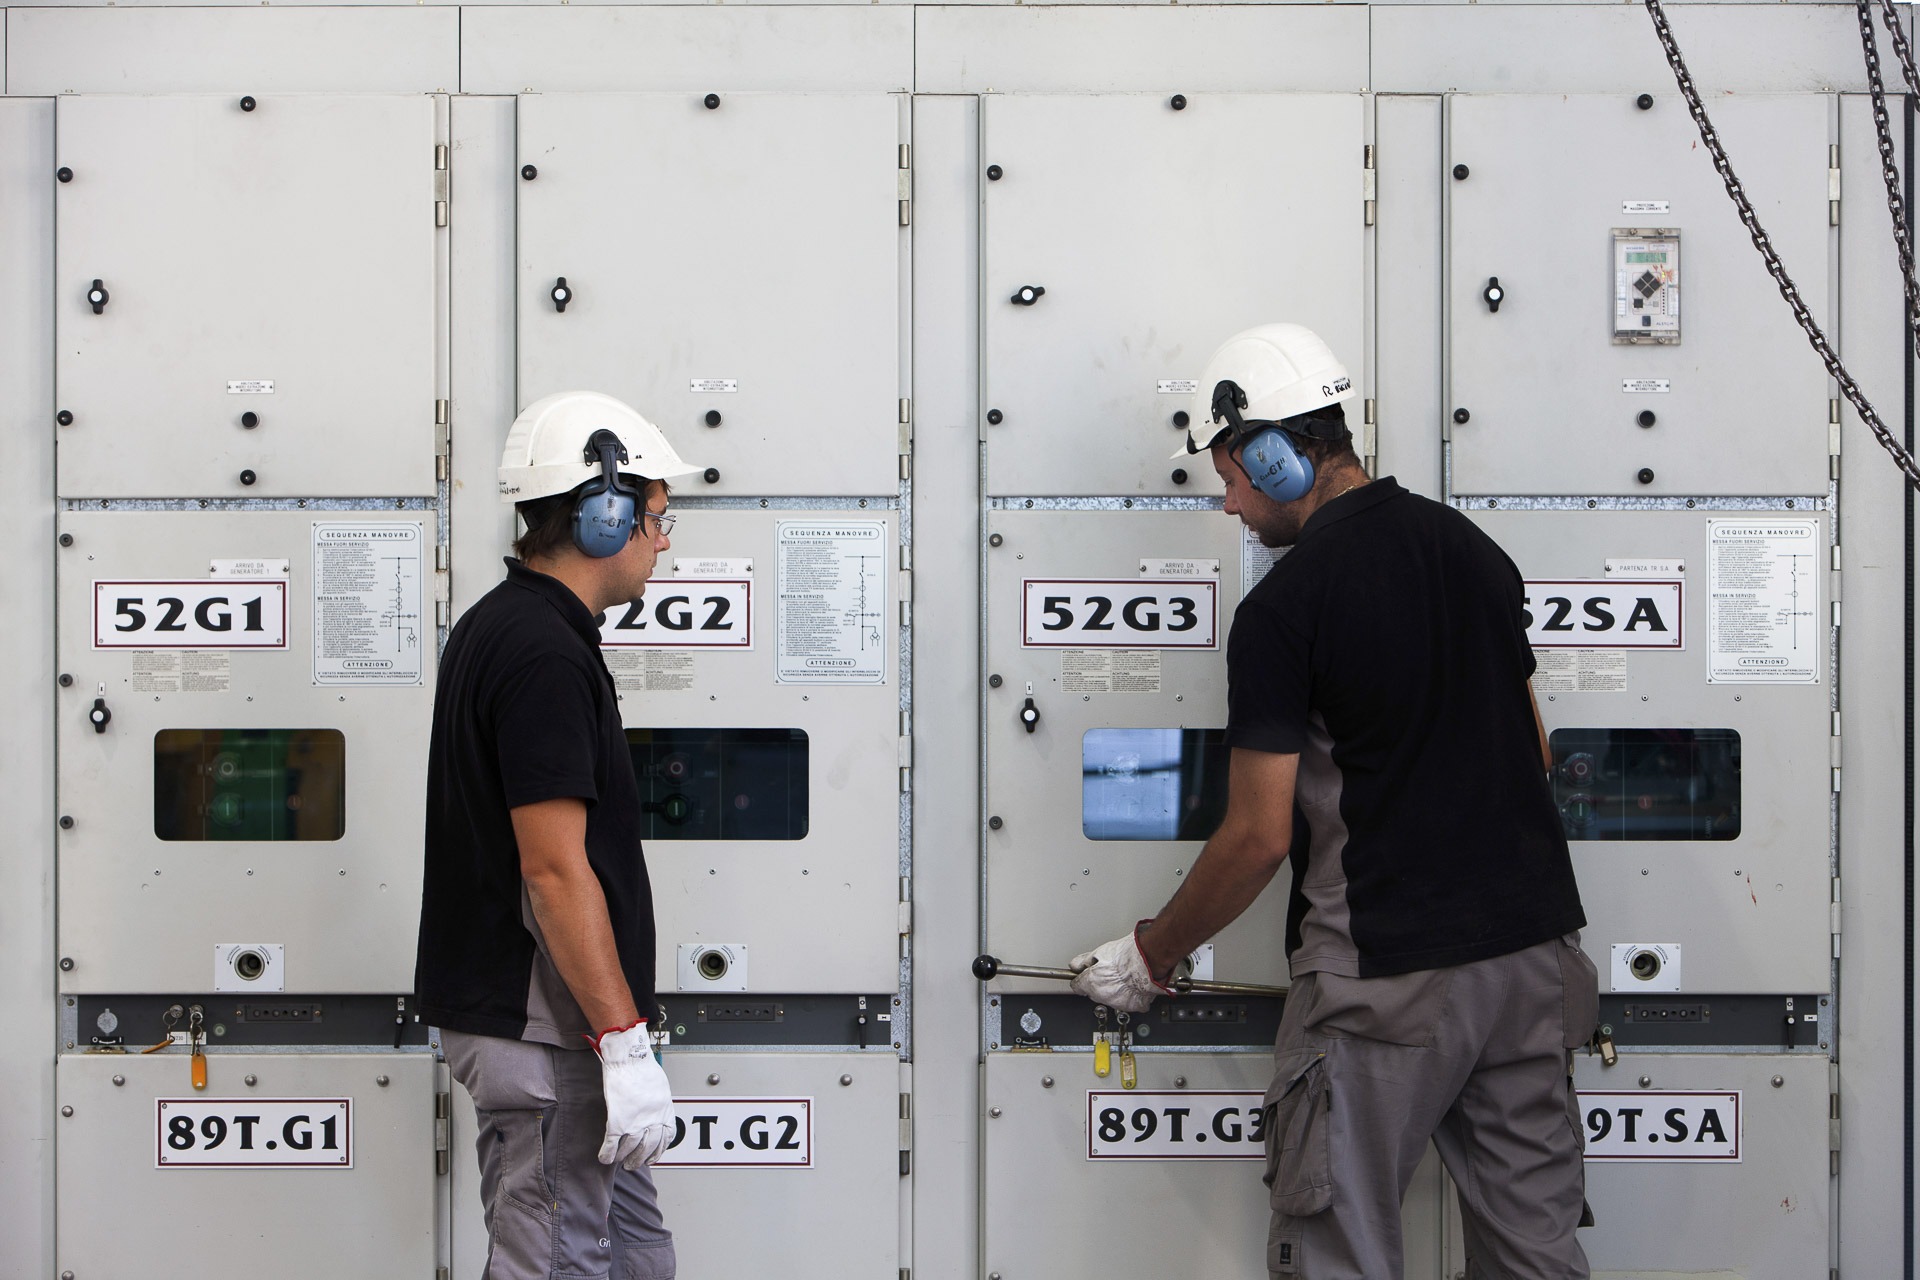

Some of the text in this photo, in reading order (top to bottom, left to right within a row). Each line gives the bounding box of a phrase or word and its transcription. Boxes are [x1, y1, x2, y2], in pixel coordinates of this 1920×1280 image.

[115, 595, 265, 632] 52G1
[596, 596, 733, 630] 2G2
[1042, 596, 1198, 631] 52G3
[168, 1115, 338, 1150] 89T.G1
[666, 1116, 801, 1150] T.G2
[1098, 1107, 1265, 1142] 89T.G3
[1587, 1108, 1728, 1142] 9T.SA
